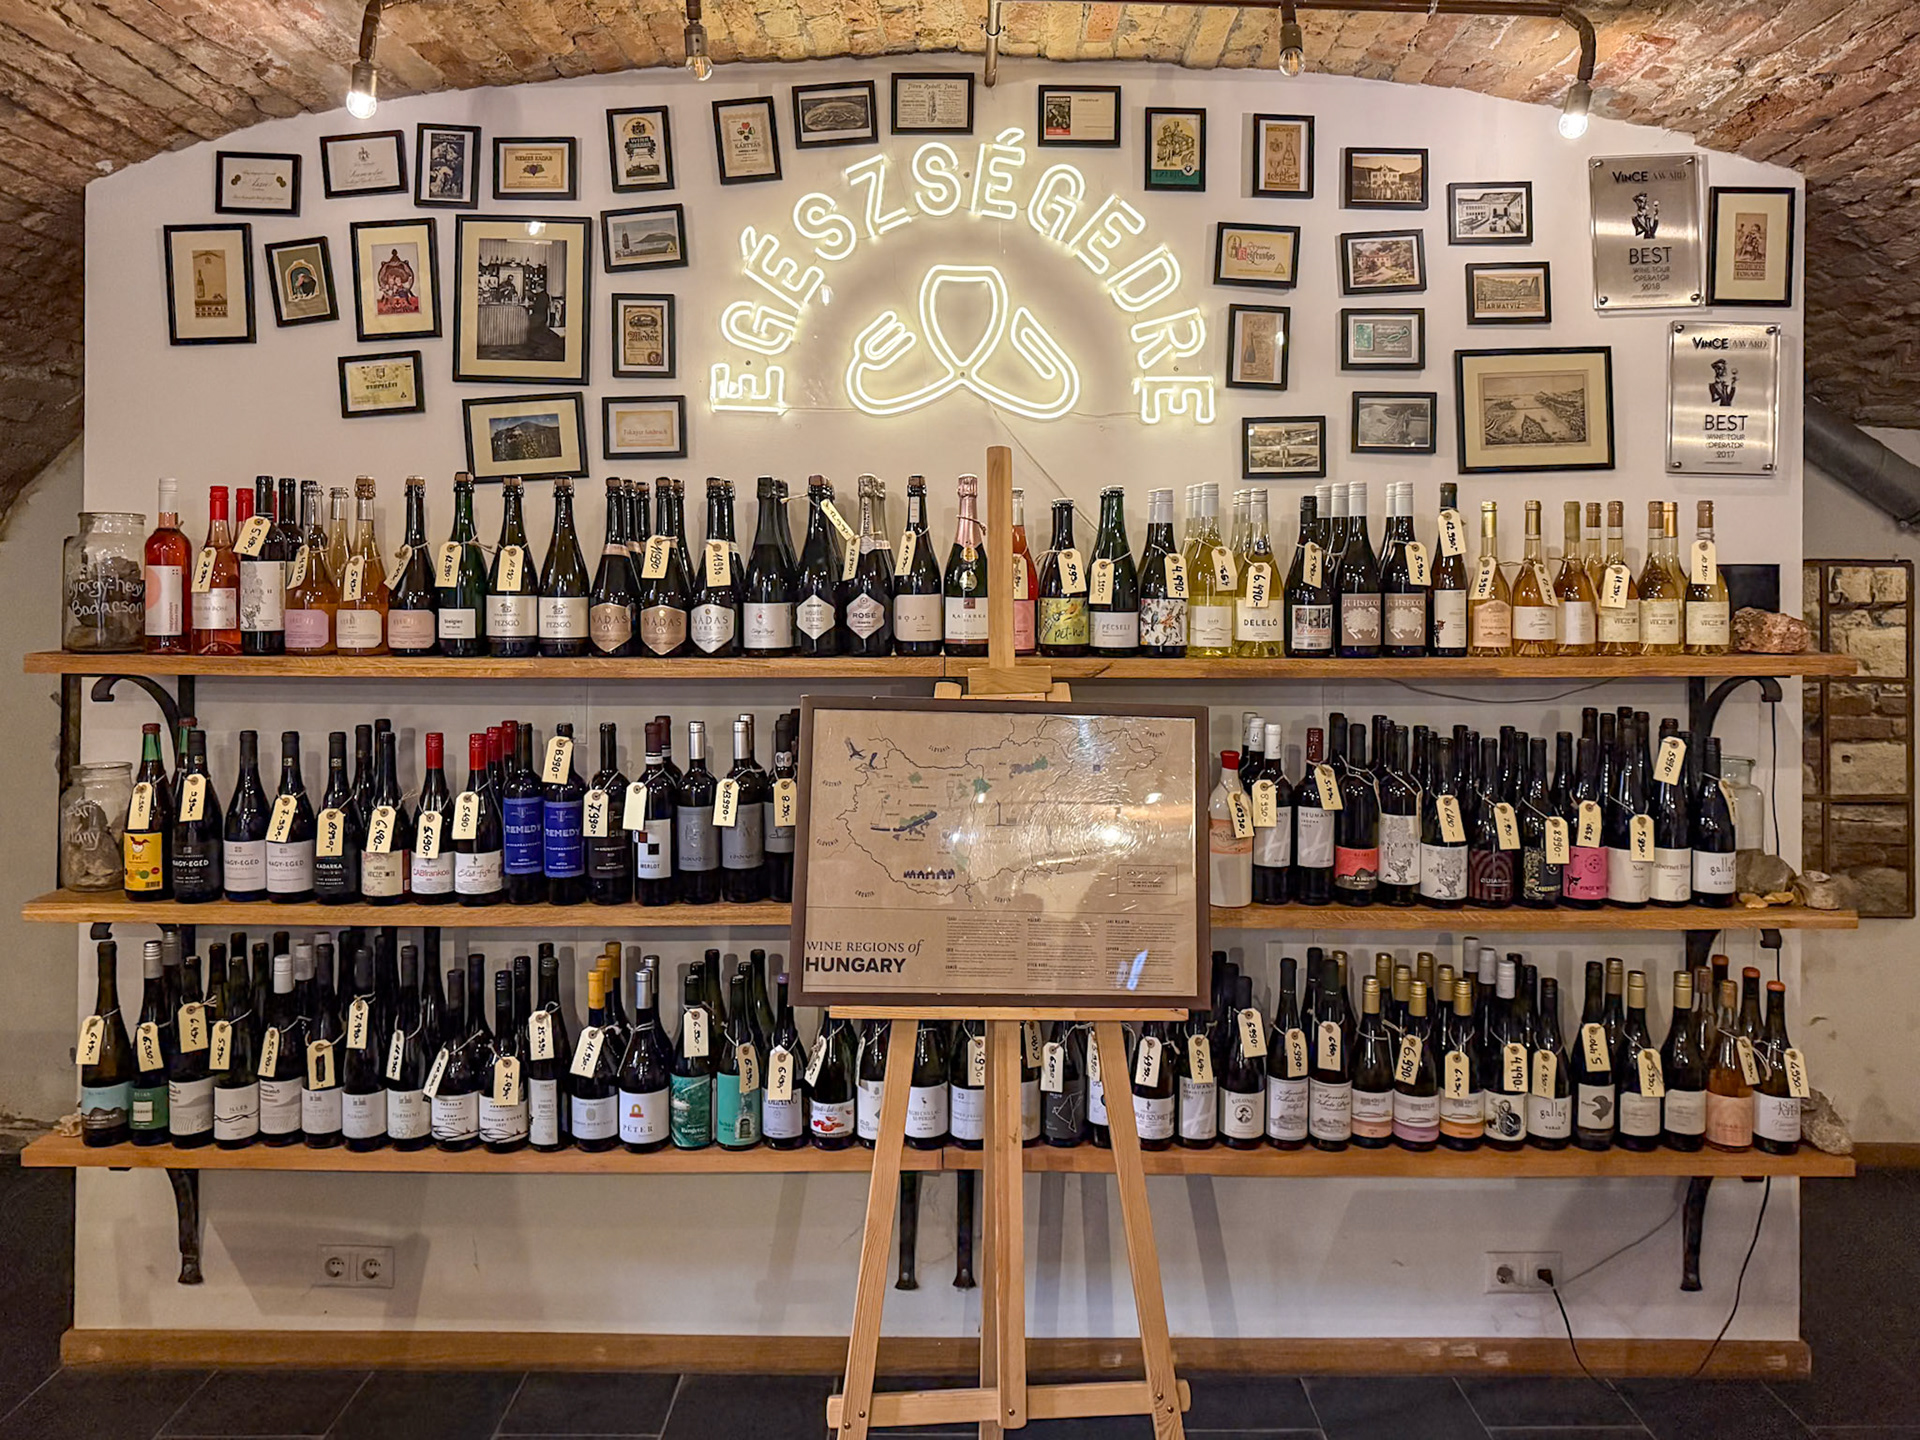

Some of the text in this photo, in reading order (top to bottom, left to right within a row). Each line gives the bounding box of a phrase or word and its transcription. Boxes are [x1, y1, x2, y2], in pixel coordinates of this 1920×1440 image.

[1629, 247, 1672, 264] BEST
[711, 127, 1217, 425] EGÉSZSÉGEDRE
[1705, 415, 1748, 432] BEST
[853, 611, 877, 619] ROSÉ
[807, 939, 924, 957] WINE REGIONS of
[805, 957, 907, 973] HUNGARY
